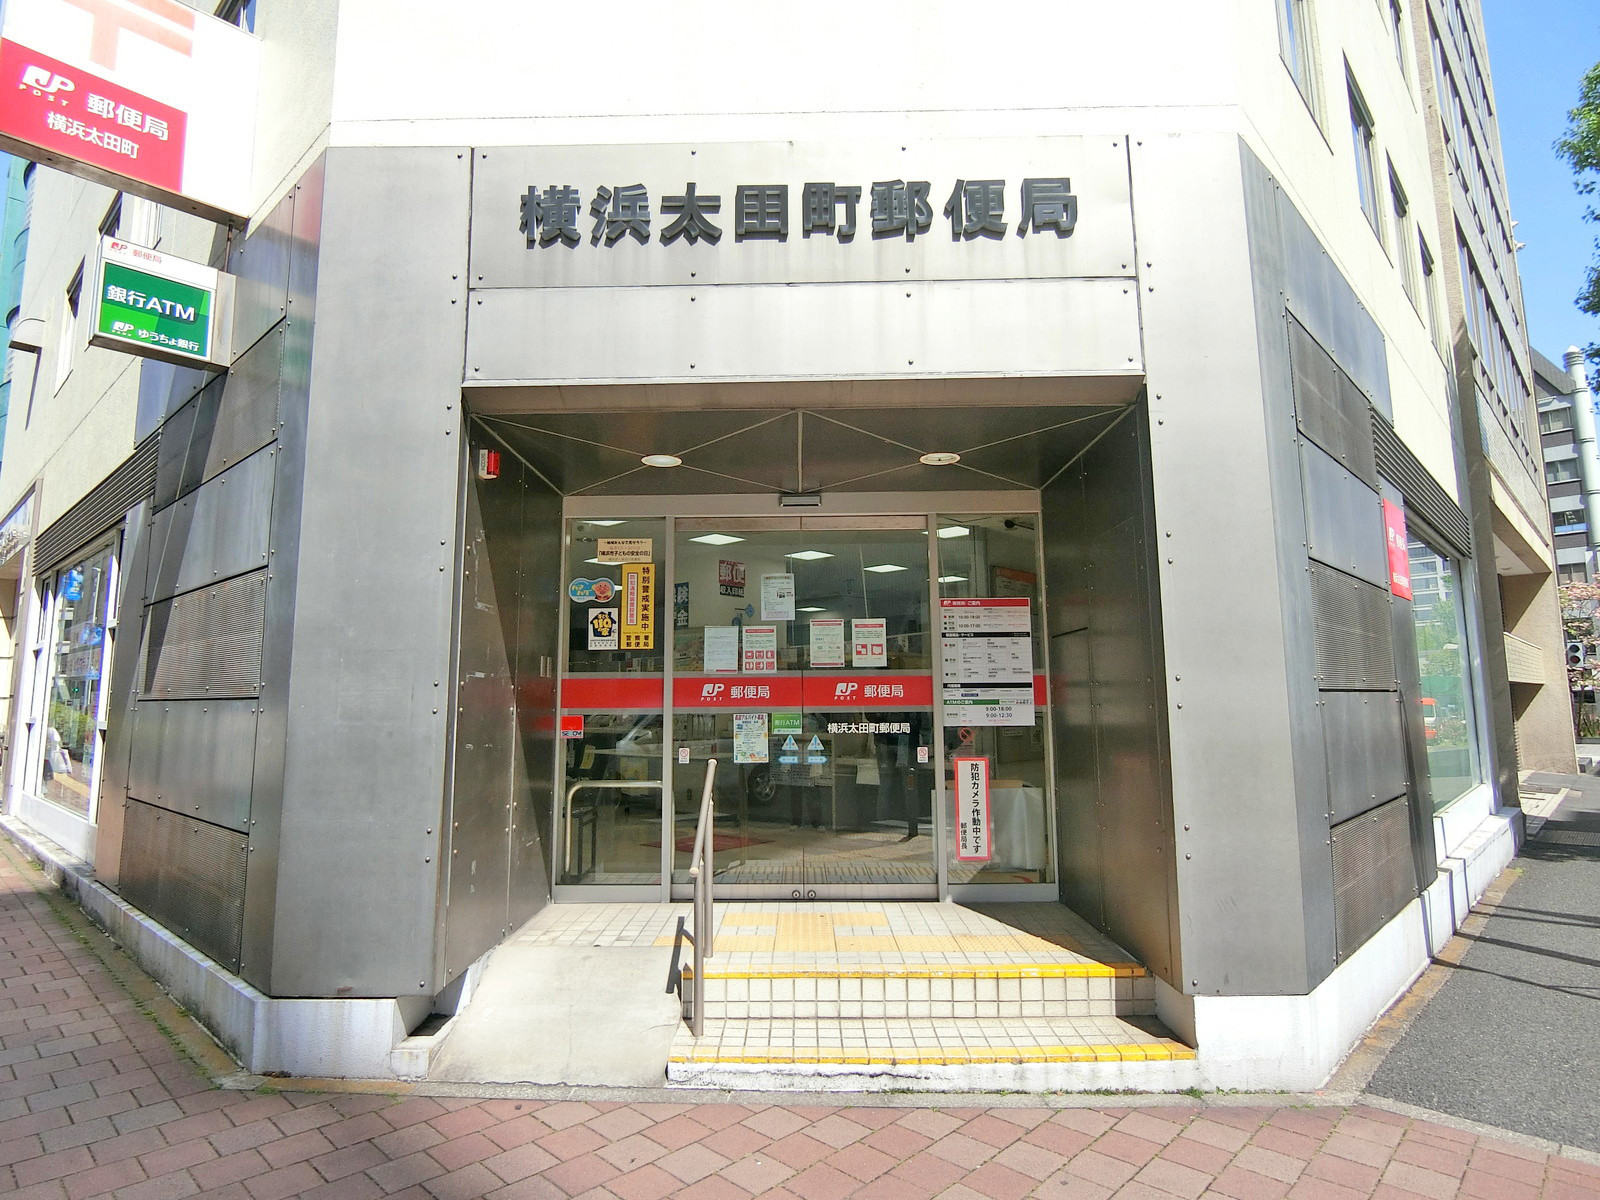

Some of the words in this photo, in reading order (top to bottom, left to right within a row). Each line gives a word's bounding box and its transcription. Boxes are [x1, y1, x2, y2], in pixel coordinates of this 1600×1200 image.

[18, 83, 70, 107] POST
[87, 92, 169, 141] 郵便局
[47, 111, 139, 159] 横浜太田町
[520, 178, 1078, 246] 横浜太田町郵便局
[132, 249, 162, 263] 郵便局
[106, 284, 196, 321] 銀行ATM
[138, 328, 200, 352] ゆうちょ銀行
[641, 566, 651, 631] 特別警戒実施中
[730, 685, 770, 699] 郵便局
[864, 684, 904, 698] 郵便局
[827, 722, 911, 734] 横浜太田町郵便局
[970, 763, 982, 854] 防犯カメラ作動中です
[960, 822, 968, 850] 郵便局長
